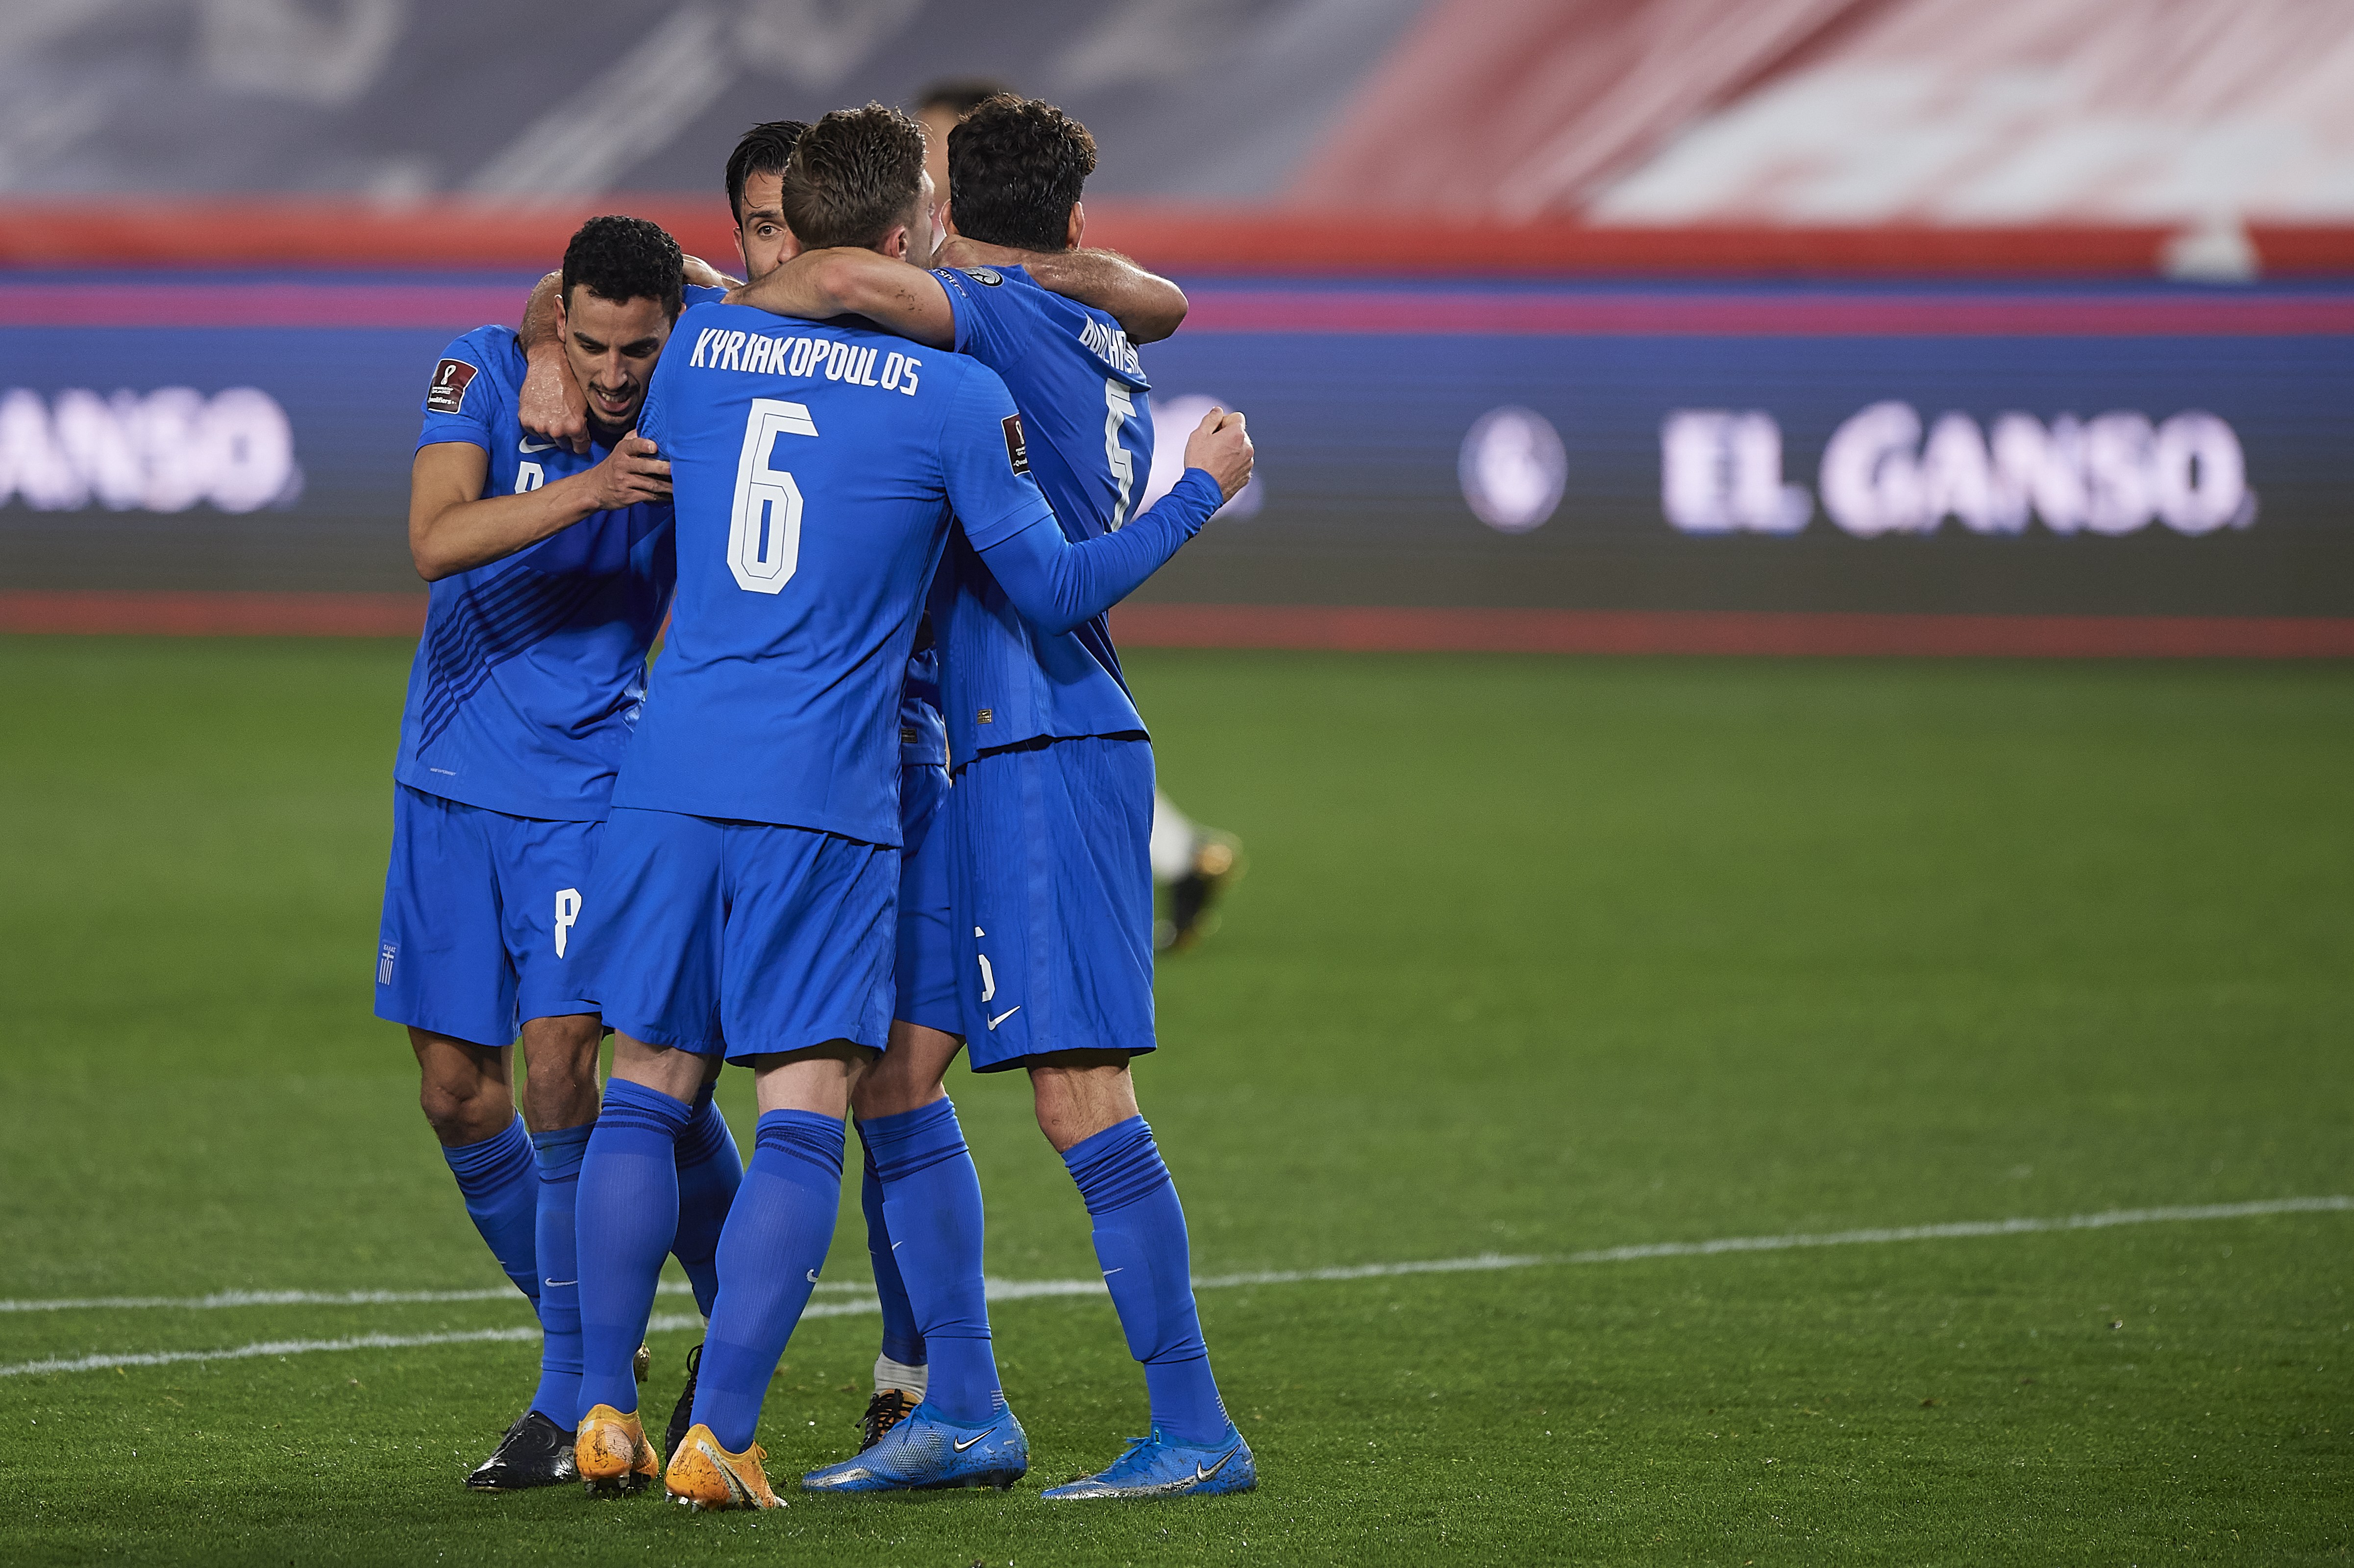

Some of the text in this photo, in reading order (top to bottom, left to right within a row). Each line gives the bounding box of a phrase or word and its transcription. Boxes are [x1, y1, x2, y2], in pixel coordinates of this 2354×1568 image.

[690, 327, 922, 396] KYRIAKOPOULOS
[727, 398, 819, 594] 6
[1661, 402, 2247, 537] EL GANSO
